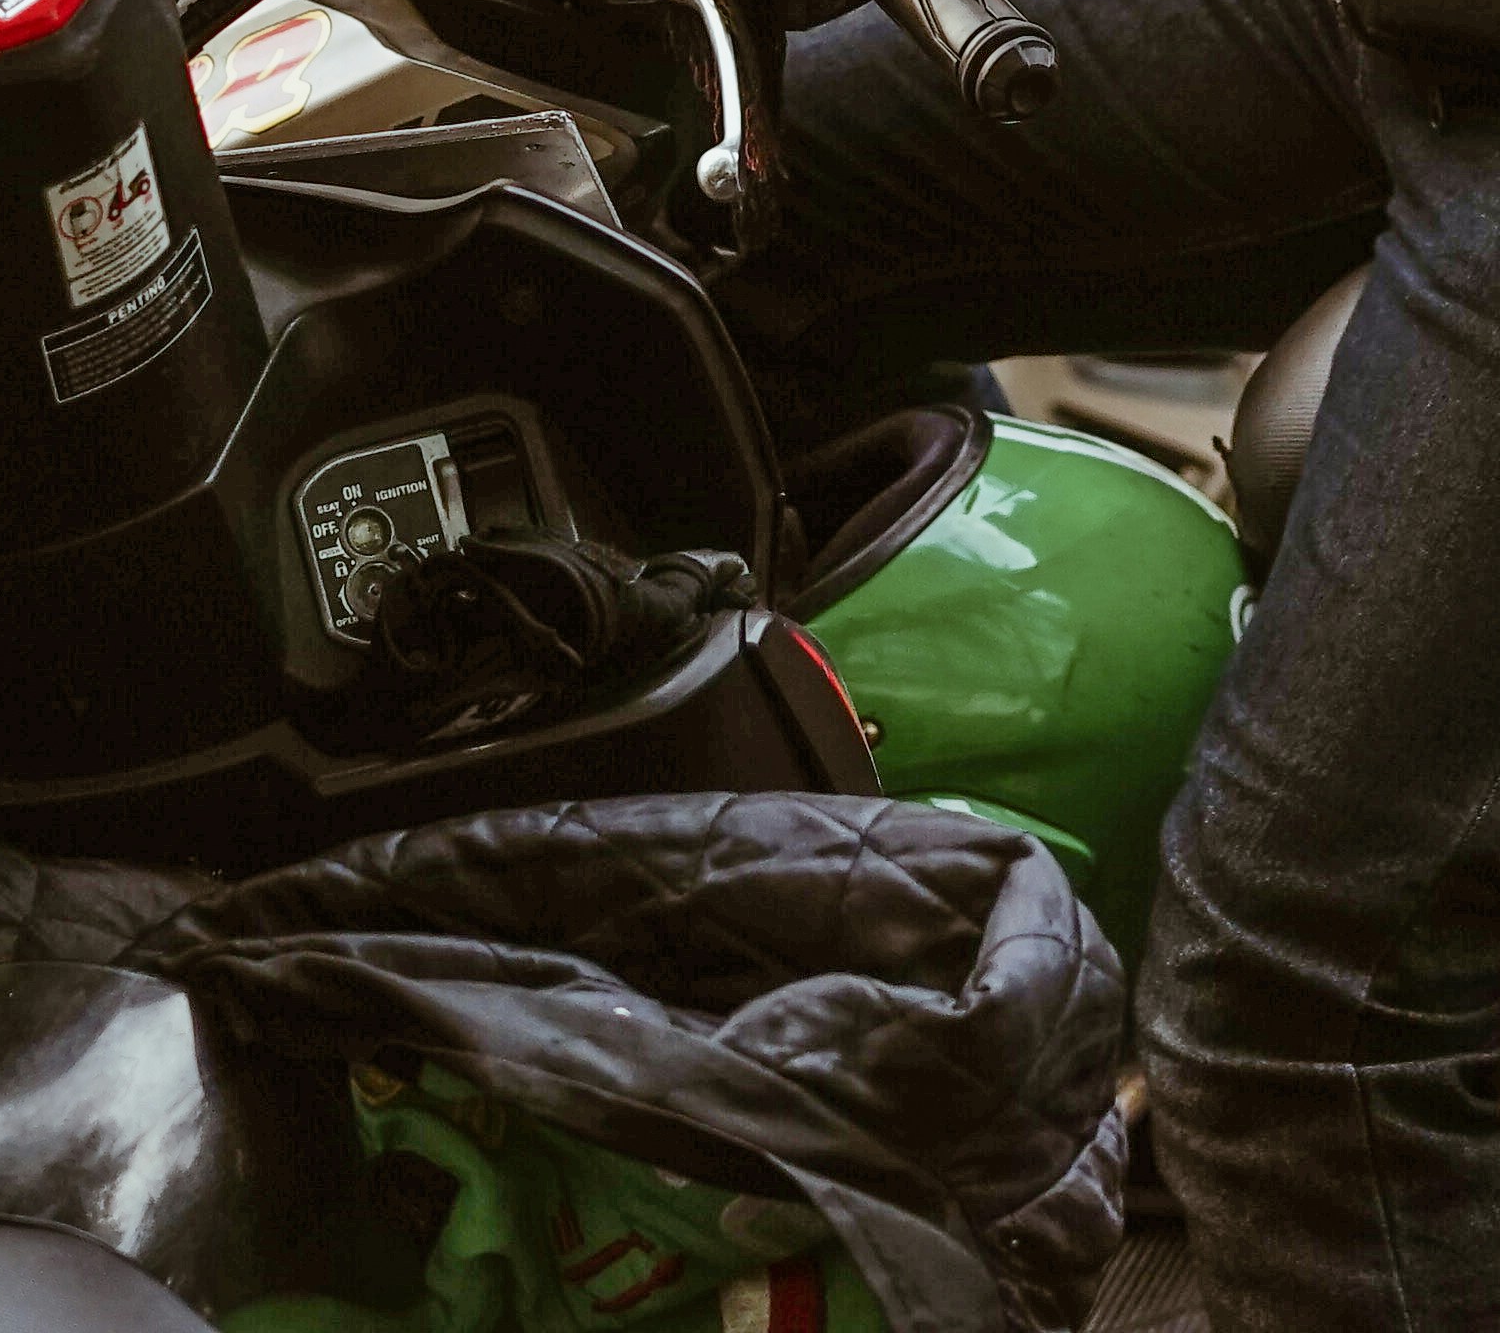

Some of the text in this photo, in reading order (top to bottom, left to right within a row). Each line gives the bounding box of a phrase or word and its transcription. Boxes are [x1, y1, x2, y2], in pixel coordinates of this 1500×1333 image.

[107, 275, 166, 325] PENTING
[342, 484, 363, 501] ON
[375, 480, 428, 502] IGNITION
[316, 501, 340, 515] SEAT
[312, 521, 337, 539] OFF
